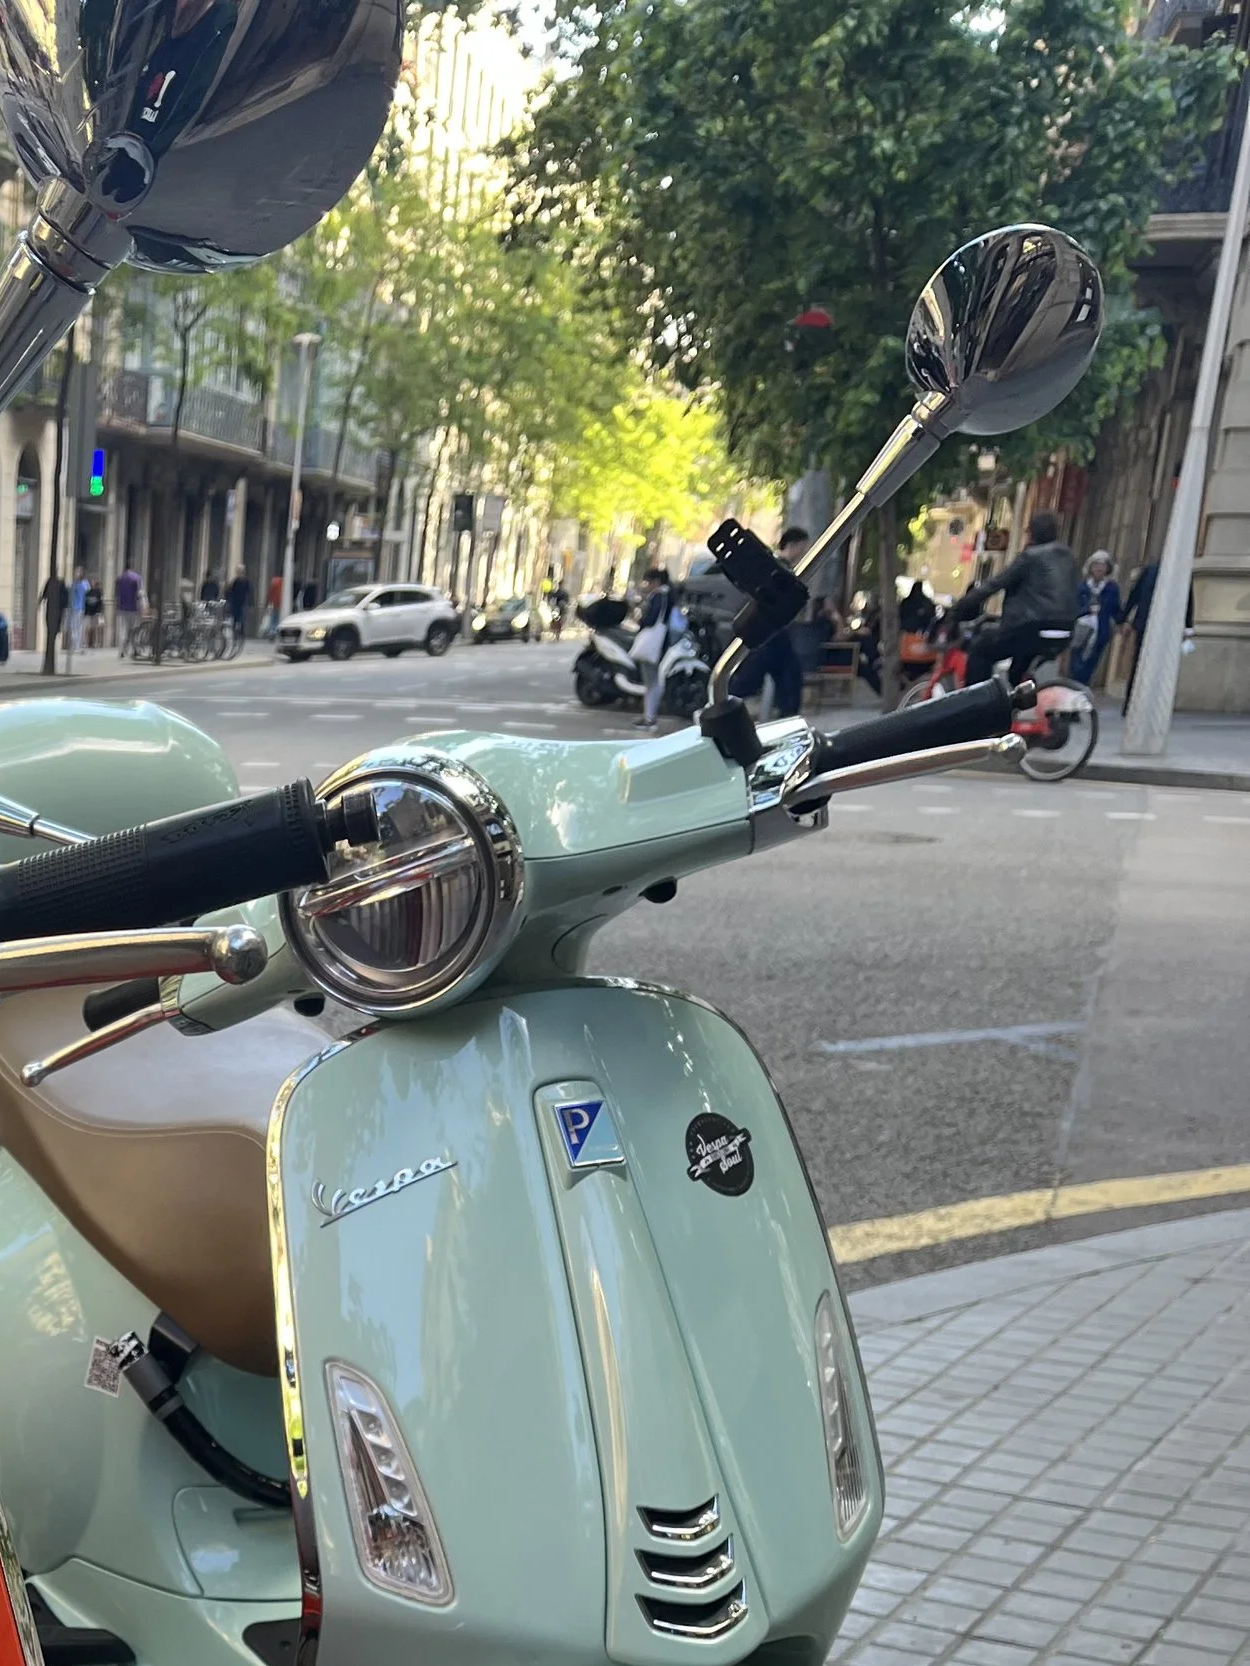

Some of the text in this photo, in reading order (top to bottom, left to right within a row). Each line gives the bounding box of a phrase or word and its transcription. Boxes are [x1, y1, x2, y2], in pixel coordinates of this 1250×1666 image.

[560, 1108, 590, 1145] P
[696, 1133, 729, 1157] Vespa
[311, 1157, 458, 1228] Vespa
